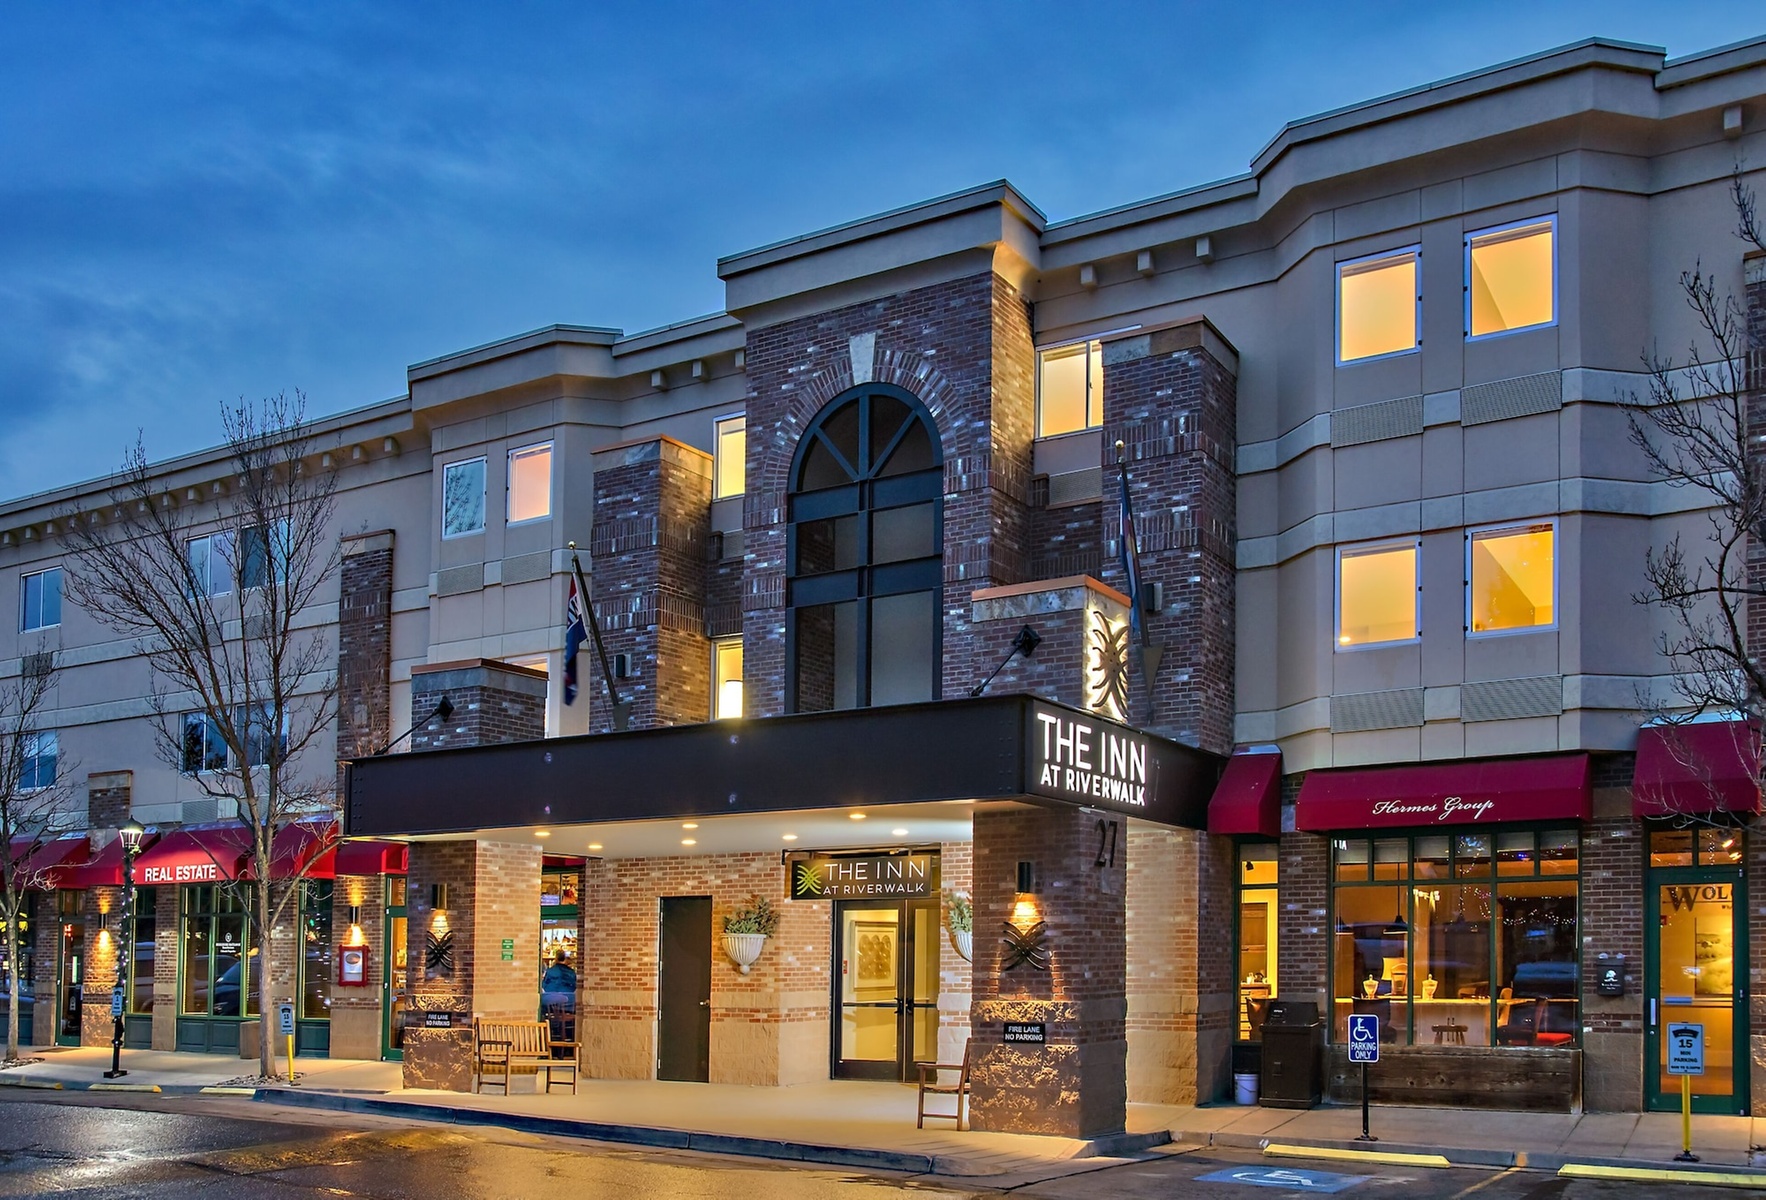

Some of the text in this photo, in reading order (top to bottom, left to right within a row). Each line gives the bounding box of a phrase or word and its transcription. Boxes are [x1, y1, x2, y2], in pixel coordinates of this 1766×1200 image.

[1037, 712, 1146, 784] THE INN
[1040, 763, 1146, 807] AT RIVERWALK
[1372, 797, 1494, 821] Hermes Group
[1094, 818, 1118, 868] 27
[144, 864, 217, 883] REAL ESTATE
[824, 860, 925, 881] THE INN
[822, 882, 924, 896] AT RIVERWALK
[1666, 886, 1733, 912] WOL
[1008, 1025, 1022, 1033] FIRE
[1351, 1041, 1377, 1051] PARKING
[1679, 1039, 1693, 1048] 15
[1355, 1050, 1372, 1060] ONLY
